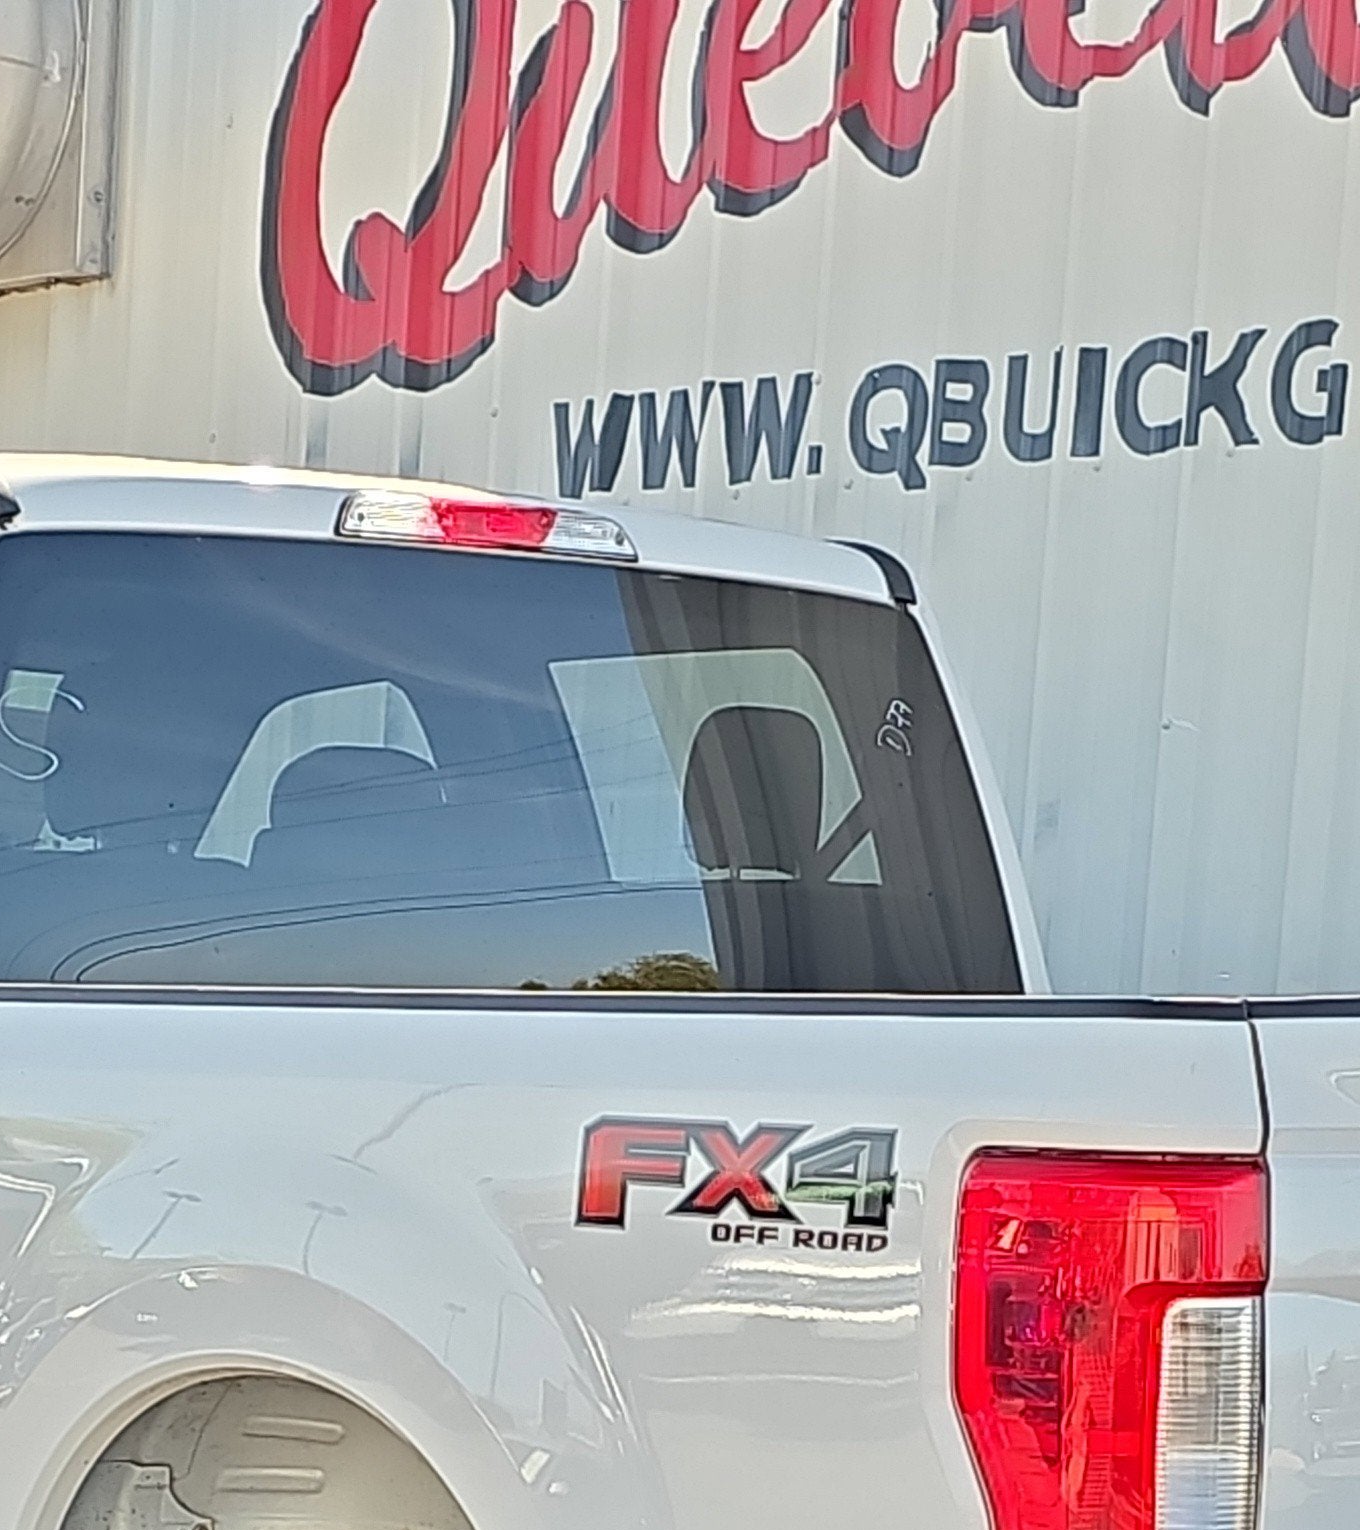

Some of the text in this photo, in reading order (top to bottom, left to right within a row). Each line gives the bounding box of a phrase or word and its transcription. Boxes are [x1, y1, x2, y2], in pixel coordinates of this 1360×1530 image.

[573, 1115, 899, 1232] FX4
[710, 1223, 889, 1252] OFF ROAD
